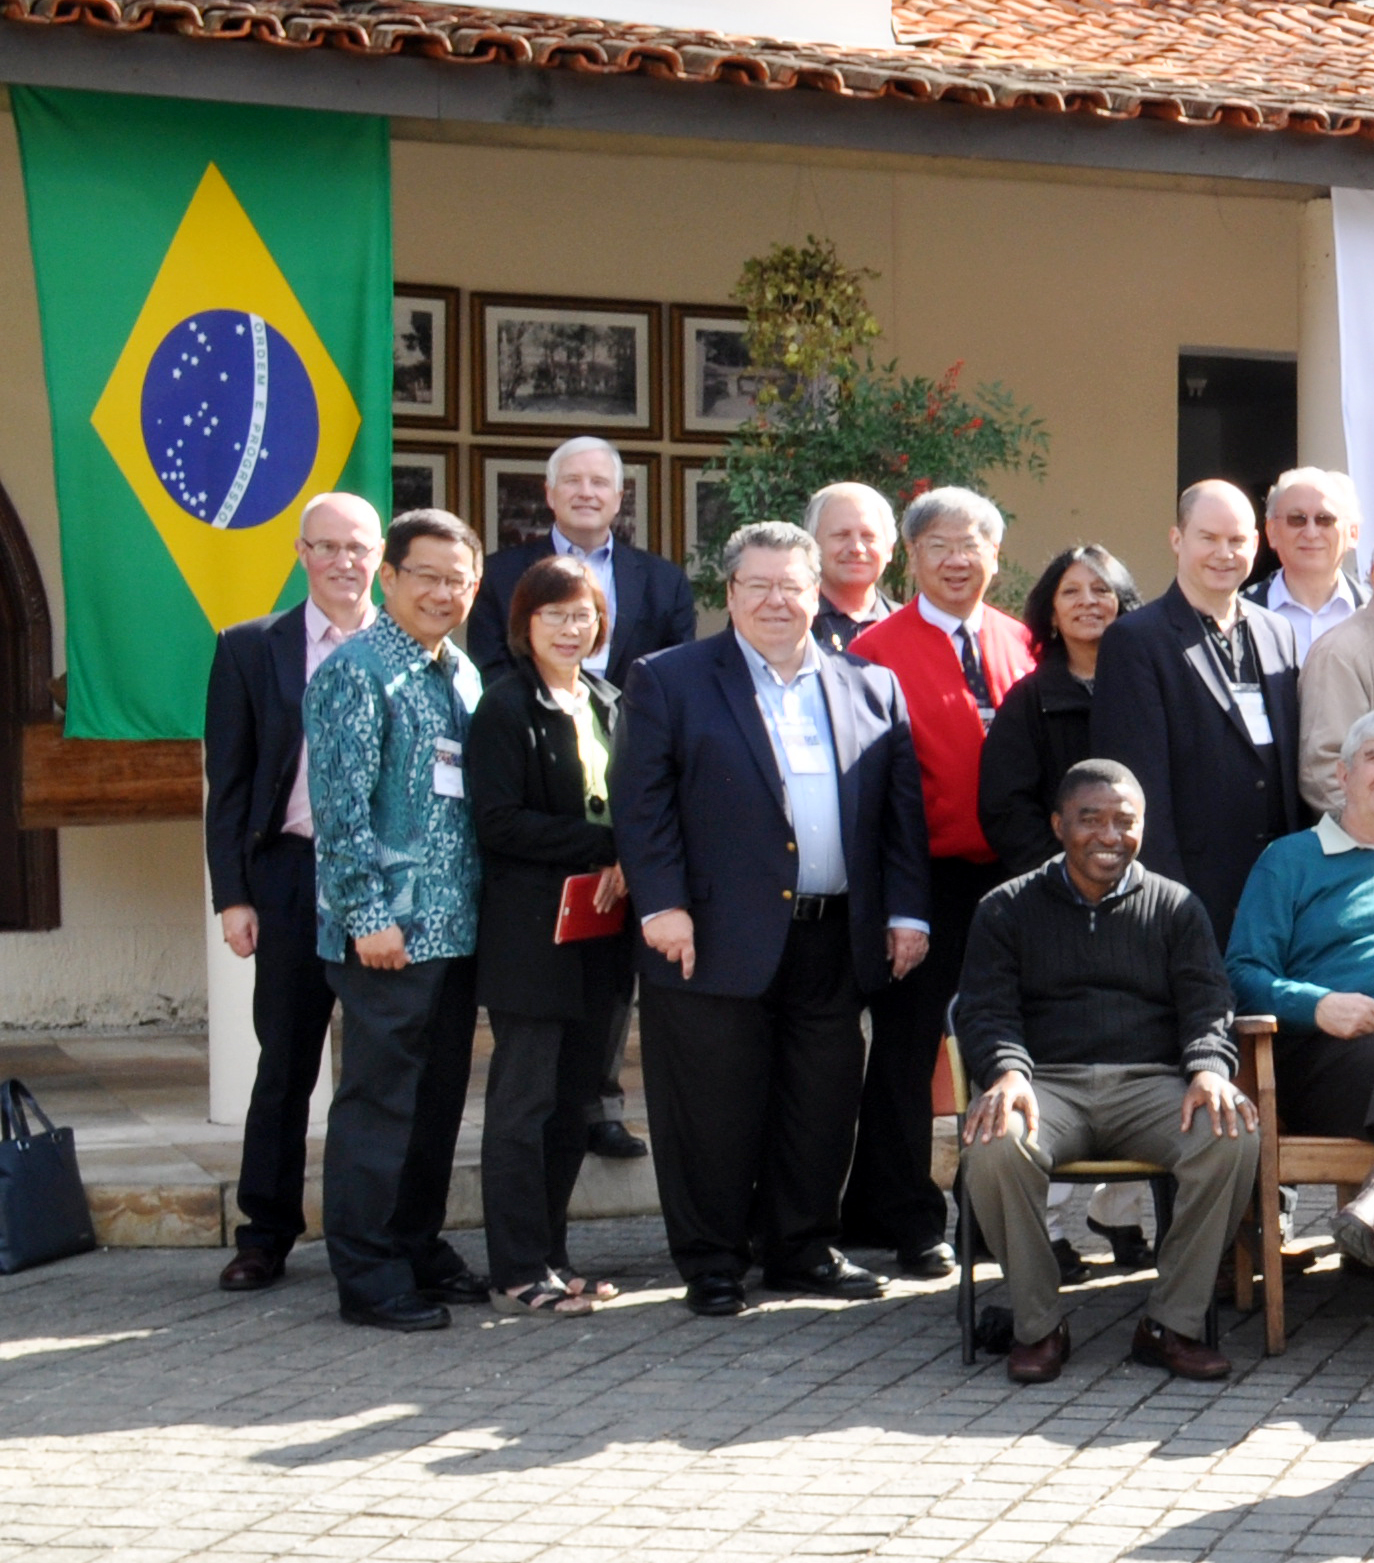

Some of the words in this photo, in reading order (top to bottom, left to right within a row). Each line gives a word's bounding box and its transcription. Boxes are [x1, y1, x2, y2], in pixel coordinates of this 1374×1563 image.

[254, 322, 266, 386] ORDEM
[255, 401, 265, 411] E
[218, 422, 262, 523] PROGRESSO
